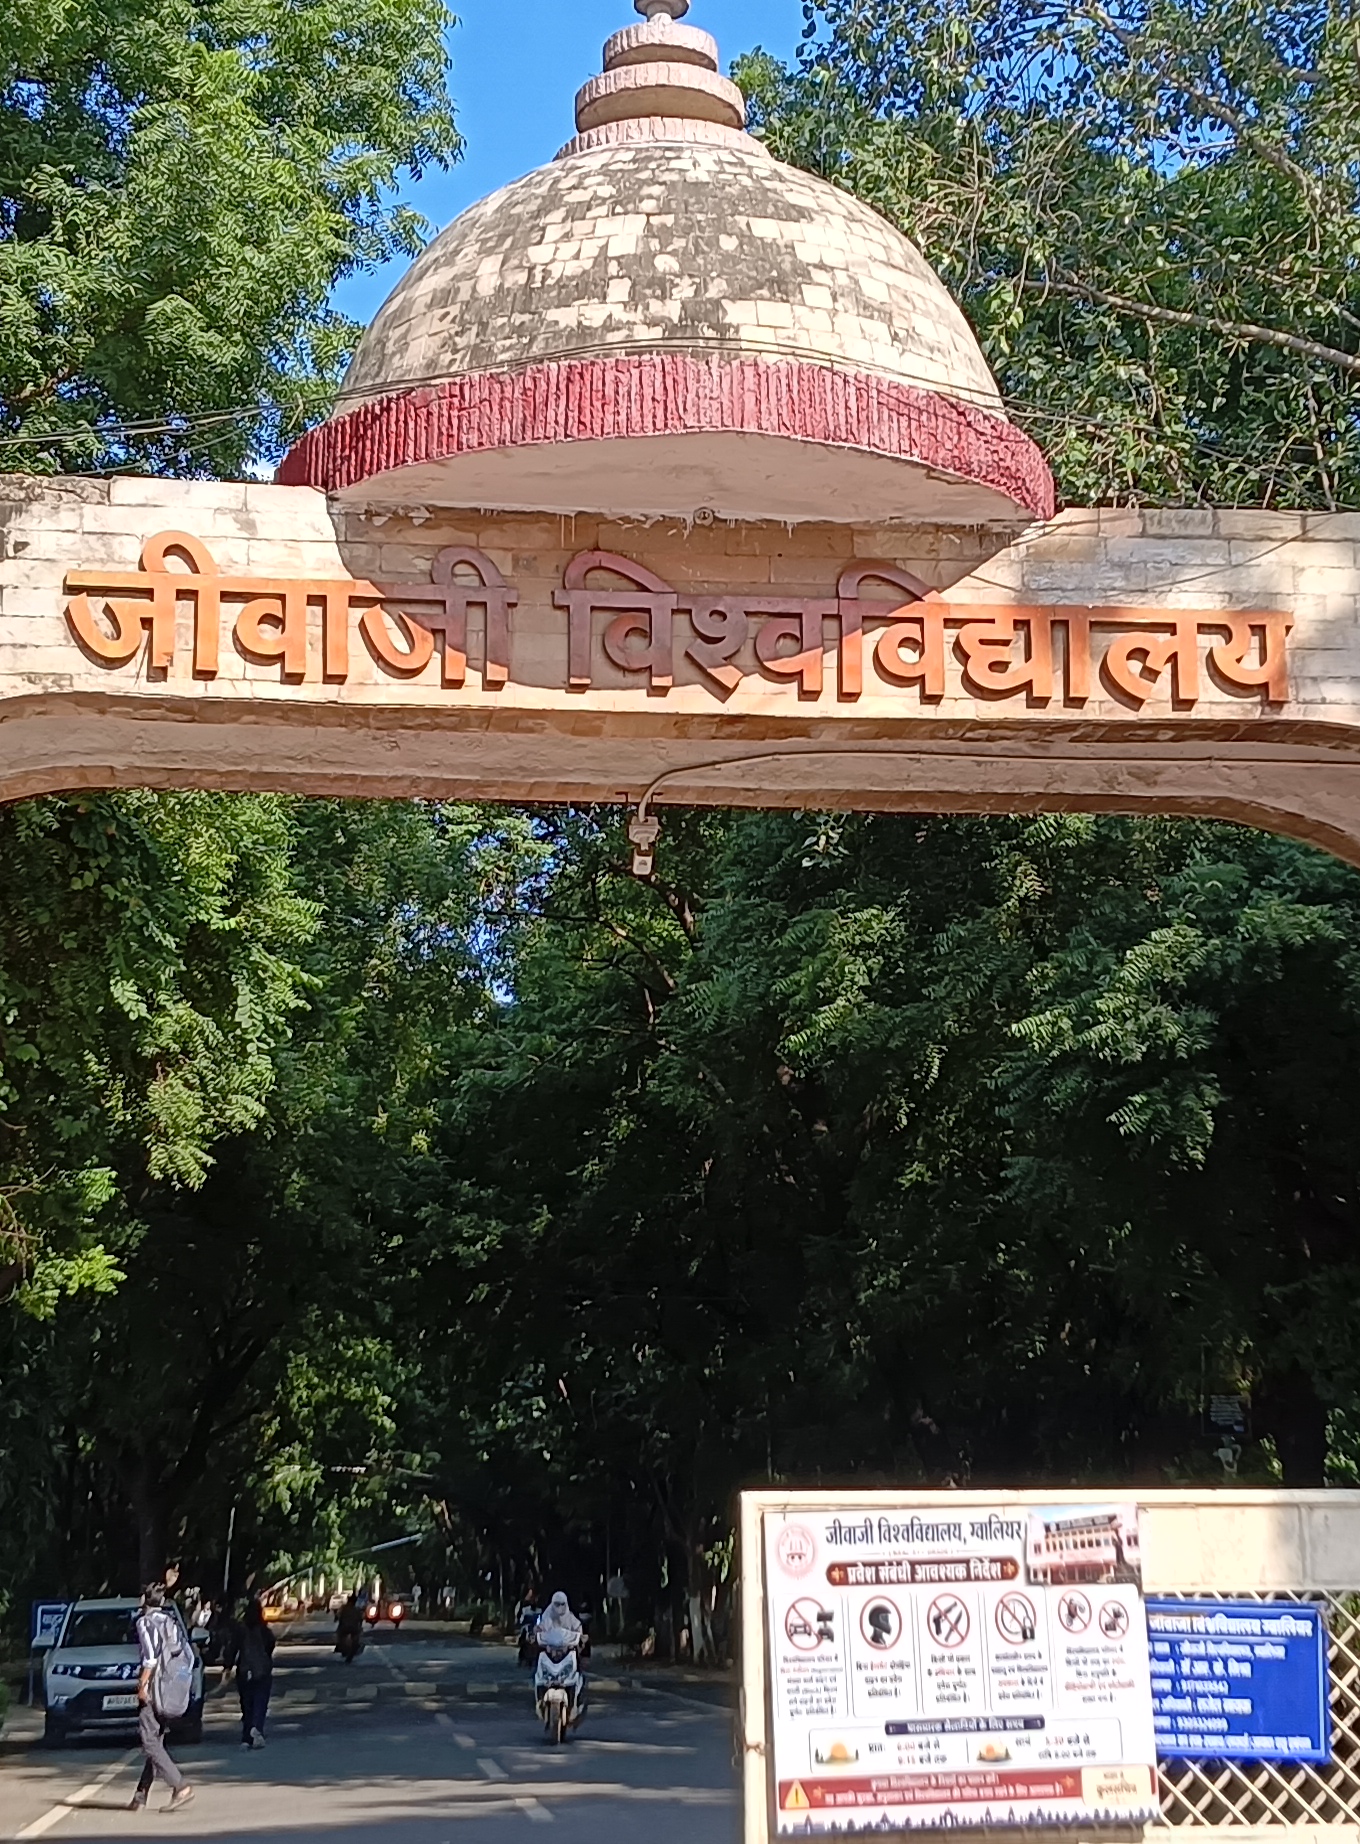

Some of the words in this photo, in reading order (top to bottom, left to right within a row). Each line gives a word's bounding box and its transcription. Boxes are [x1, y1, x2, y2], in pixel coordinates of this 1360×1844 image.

[63, 530, 518, 691] जीवाजी
[553, 548, 1295, 712] विश्वविद्यालय
[825, 1517, 874, 1546] जीवाजी
[878, 1515, 967, 1545] विश्वविद्यालय,
[969, 1513, 1023, 1541] ग्वालियर
[846, 1561, 876, 1584] प्रवेश
[878, 1559, 912, 1583] संबंधी
[914, 1562, 968, 1582] आवश्यक
[969, 1556, 1002, 1581] निर्देश
